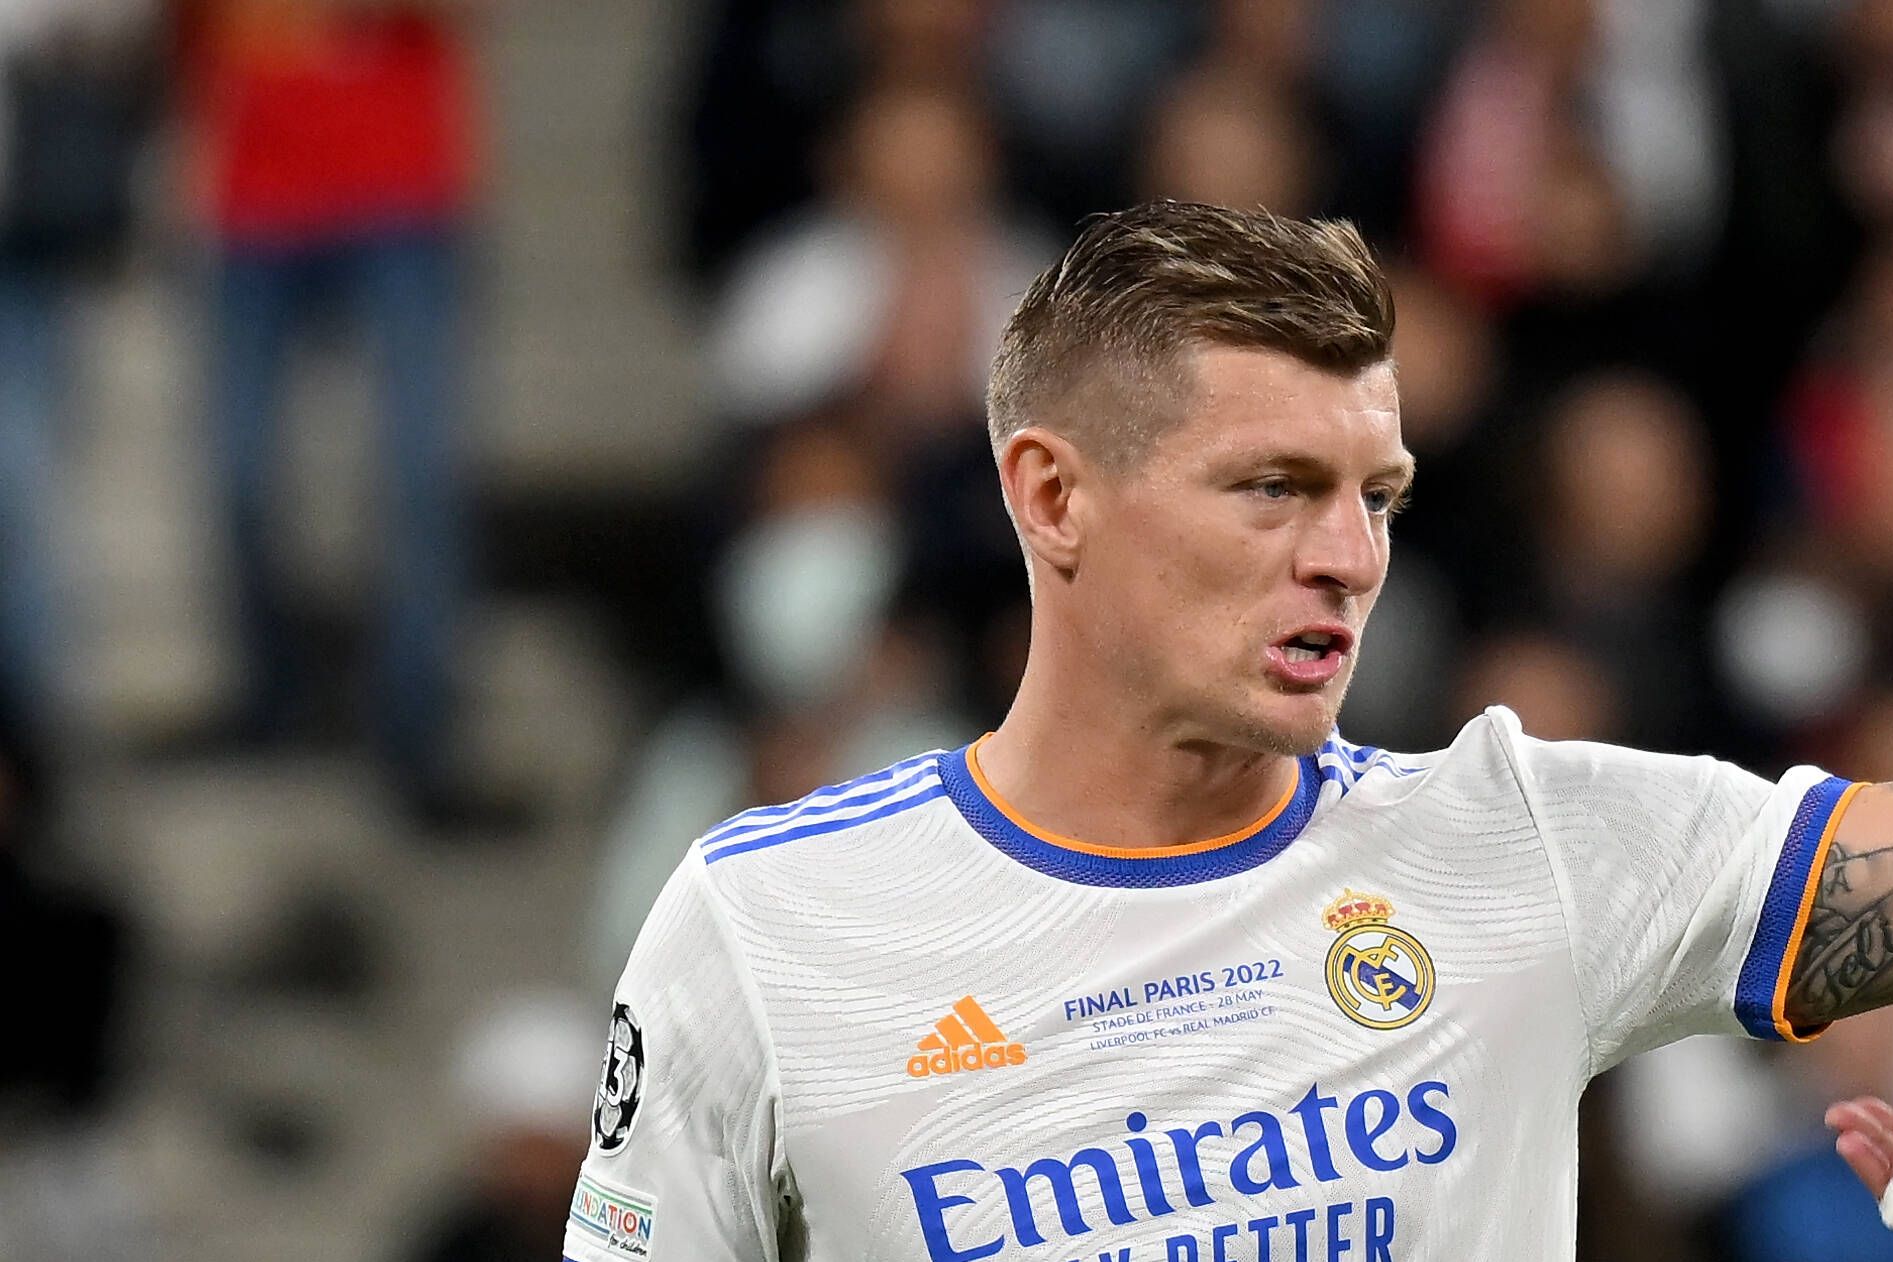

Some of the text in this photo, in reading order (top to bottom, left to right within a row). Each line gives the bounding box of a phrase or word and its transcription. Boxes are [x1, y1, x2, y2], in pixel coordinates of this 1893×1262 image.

[1064, 958, 1285, 1021] FINAL PARIS 2022
[1092, 1014, 1134, 1033] STADE
[1136, 1010, 1154, 1024] DE
[1156, 1000, 1207, 1020] FRANCE
[1218, 995, 1233, 1009] 28
[1236, 989, 1264, 1004] MAY
[1090, 1031, 1152, 1051] LIVERPOOL
[1152, 1027, 1168, 1040] FC
[1183, 1019, 1212, 1034] REAL
[1213, 1008, 1259, 1027] MADRID
[1260, 1005, 1275, 1017] CF
[906, 1038, 1028, 1078] adidas
